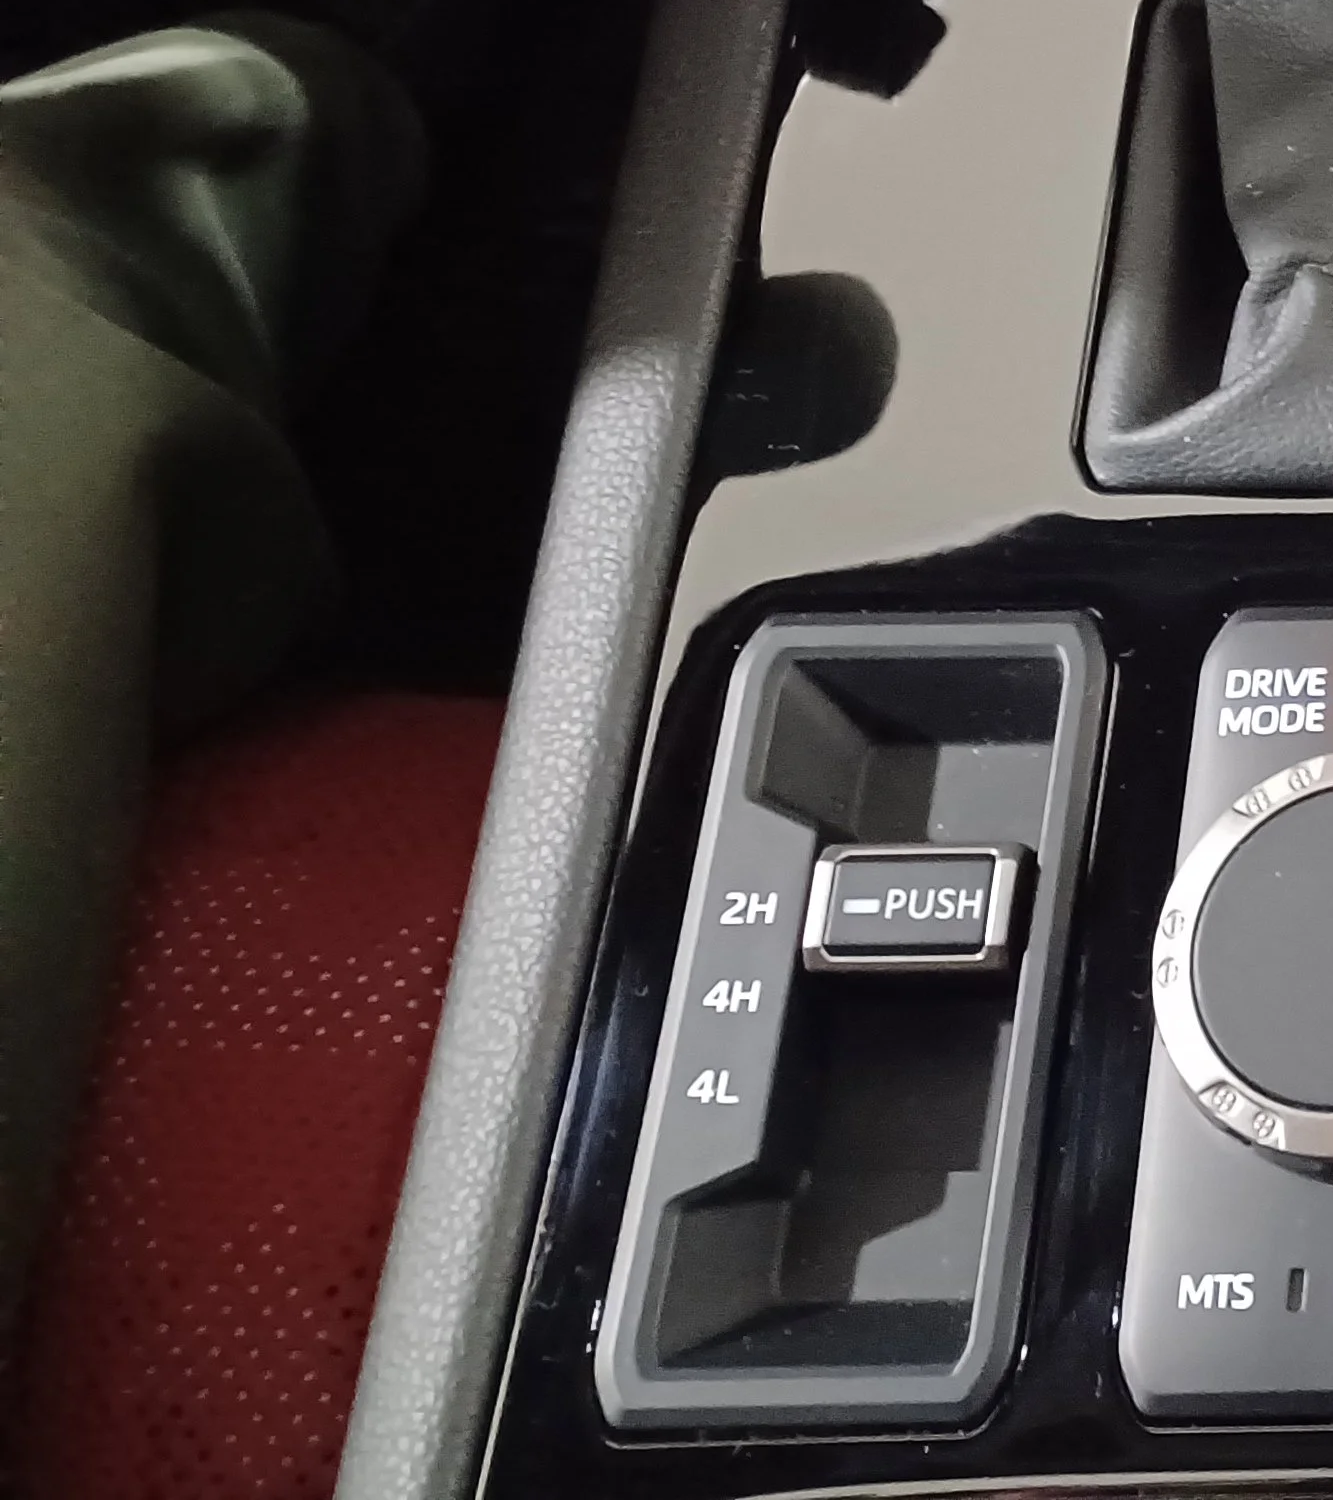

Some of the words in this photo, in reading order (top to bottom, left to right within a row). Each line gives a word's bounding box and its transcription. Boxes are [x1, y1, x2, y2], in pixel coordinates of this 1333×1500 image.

[1224, 666, 1328, 699] DRIVE
[1217, 701, 1326, 737] MODE
[719, 892, 778, 925] 2H
[884, 887, 984, 921] PUSH
[702, 980, 761, 1013] 4H
[686, 1069, 740, 1105] 4L
[1177, 1273, 1255, 1311] MTS
